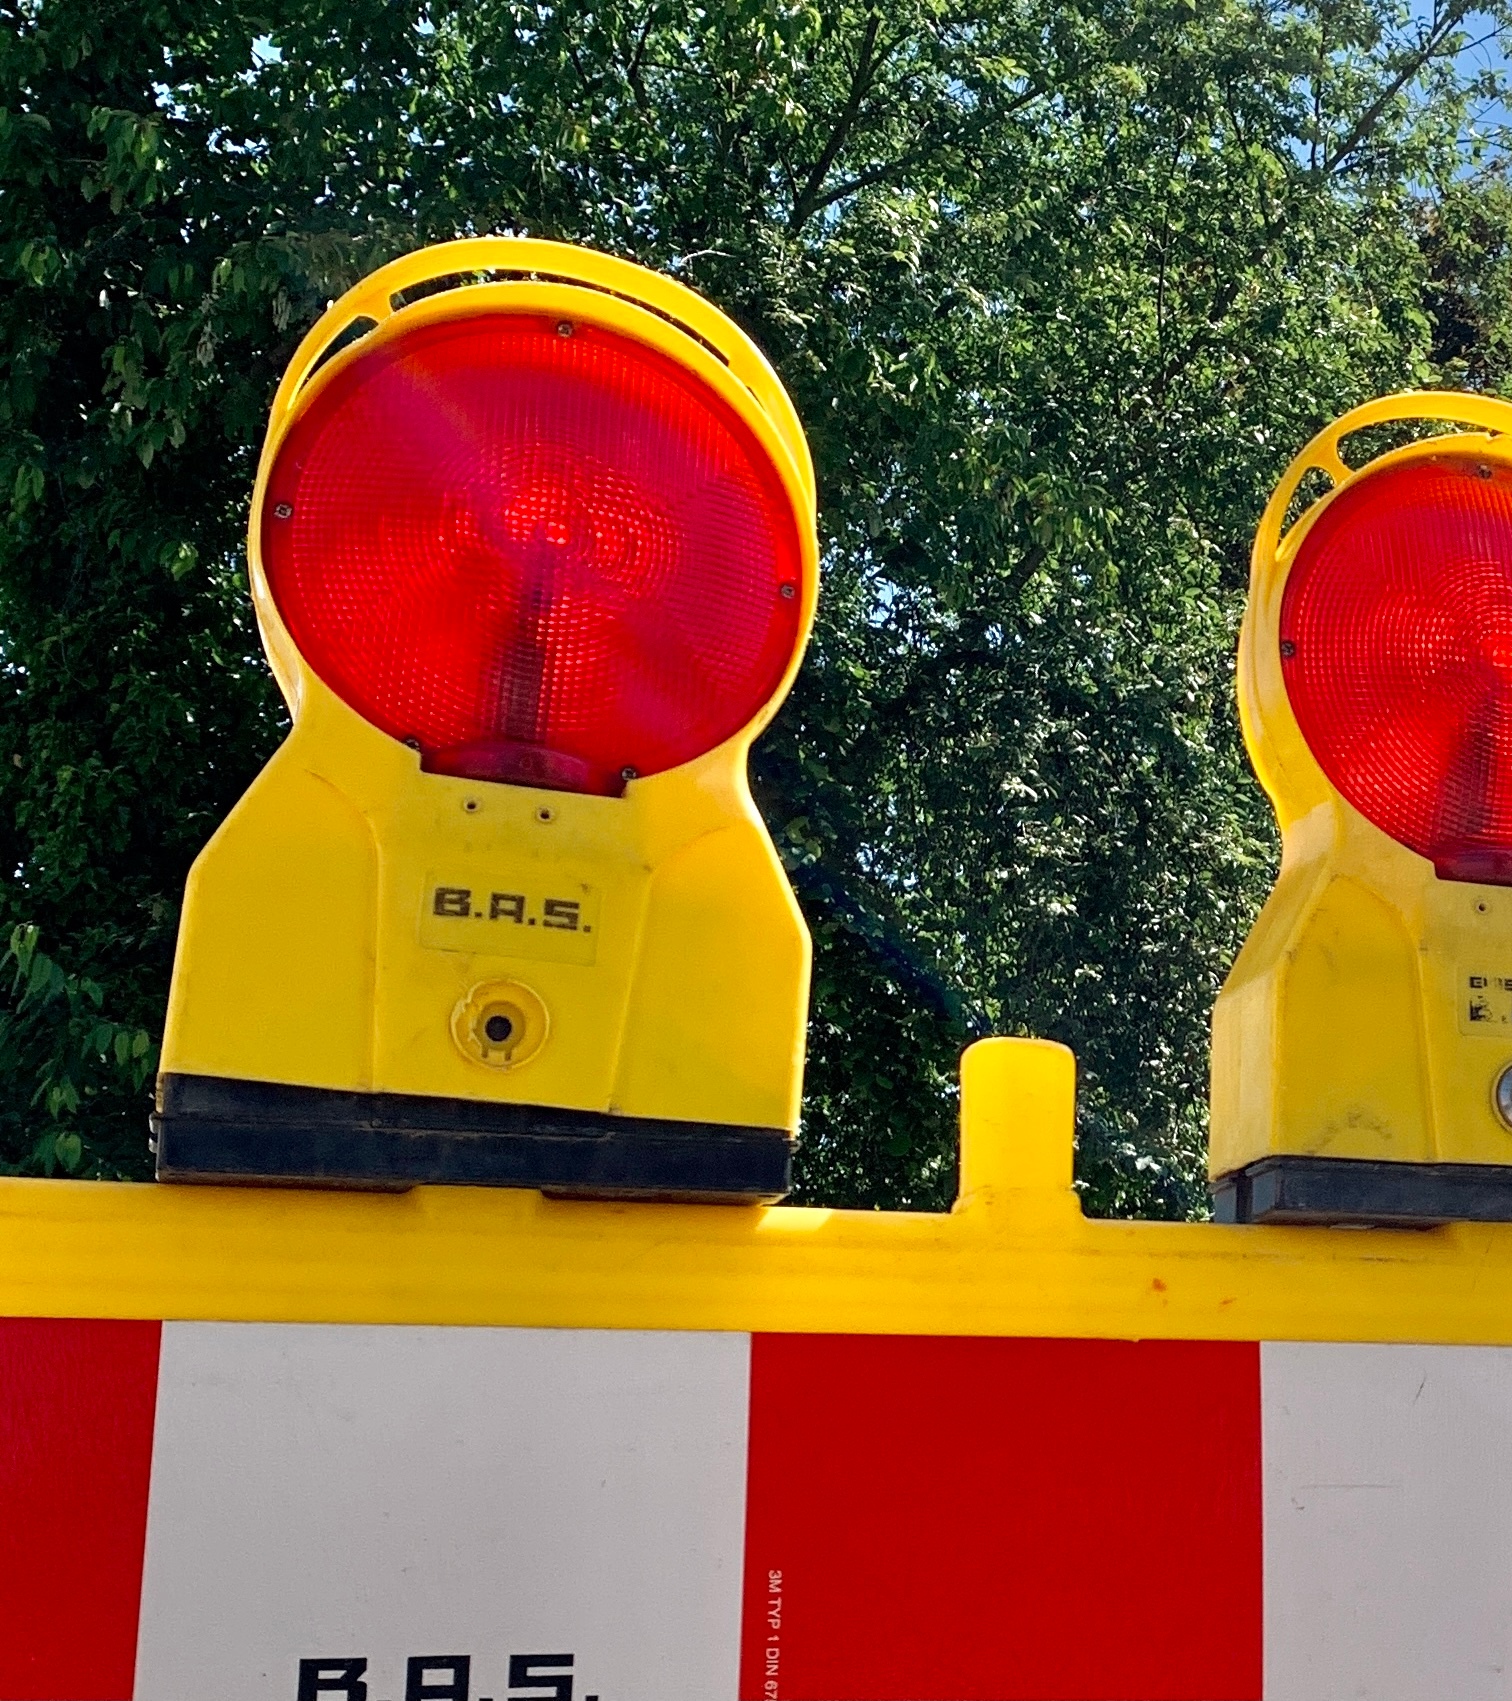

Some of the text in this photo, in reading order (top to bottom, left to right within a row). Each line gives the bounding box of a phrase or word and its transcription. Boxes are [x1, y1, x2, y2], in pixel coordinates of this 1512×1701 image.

[433, 886, 591, 933] B.A.S.
[768, 1570, 783, 1593] 3M
[767, 1597, 782, 1630] TYP
[765, 1648, 780, 1675] DIN
[297, 1654, 599, 1701] BAS
[764, 1680, 779, 1701] 67
